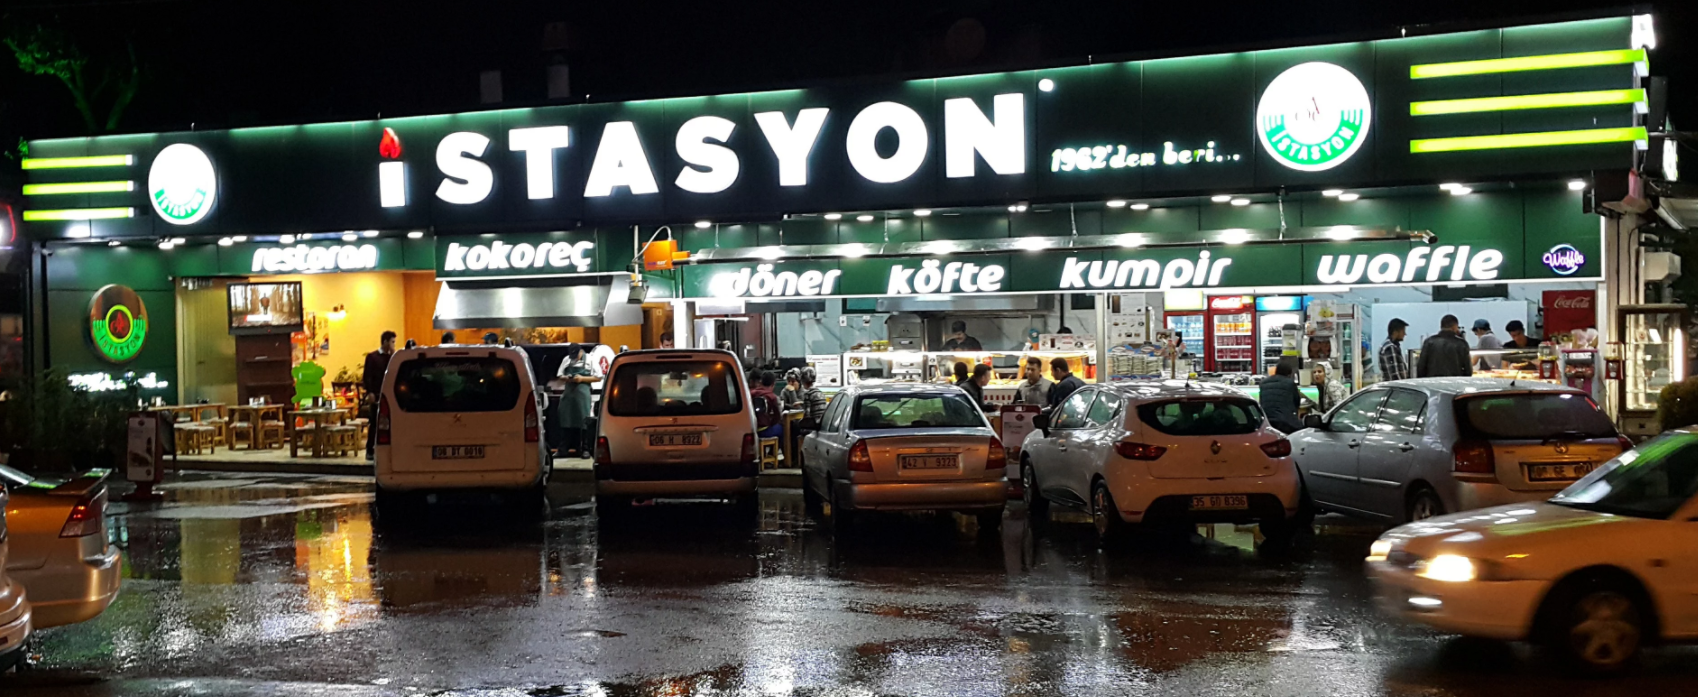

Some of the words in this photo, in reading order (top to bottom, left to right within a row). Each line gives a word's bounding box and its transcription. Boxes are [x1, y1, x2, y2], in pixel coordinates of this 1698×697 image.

[251, 244, 378, 272] restoran
[444, 241, 594, 272] kokoreç
[1059, 250, 1232, 289] kumpir
[1316, 245, 1503, 283] waffle
[1543, 250, 1585, 268] Waffle
[709, 263, 841, 298] döner
[887, 259, 1005, 295] köfte
[936, 457, 957, 468] 9323
[1194, 496, 1205, 507] 35
